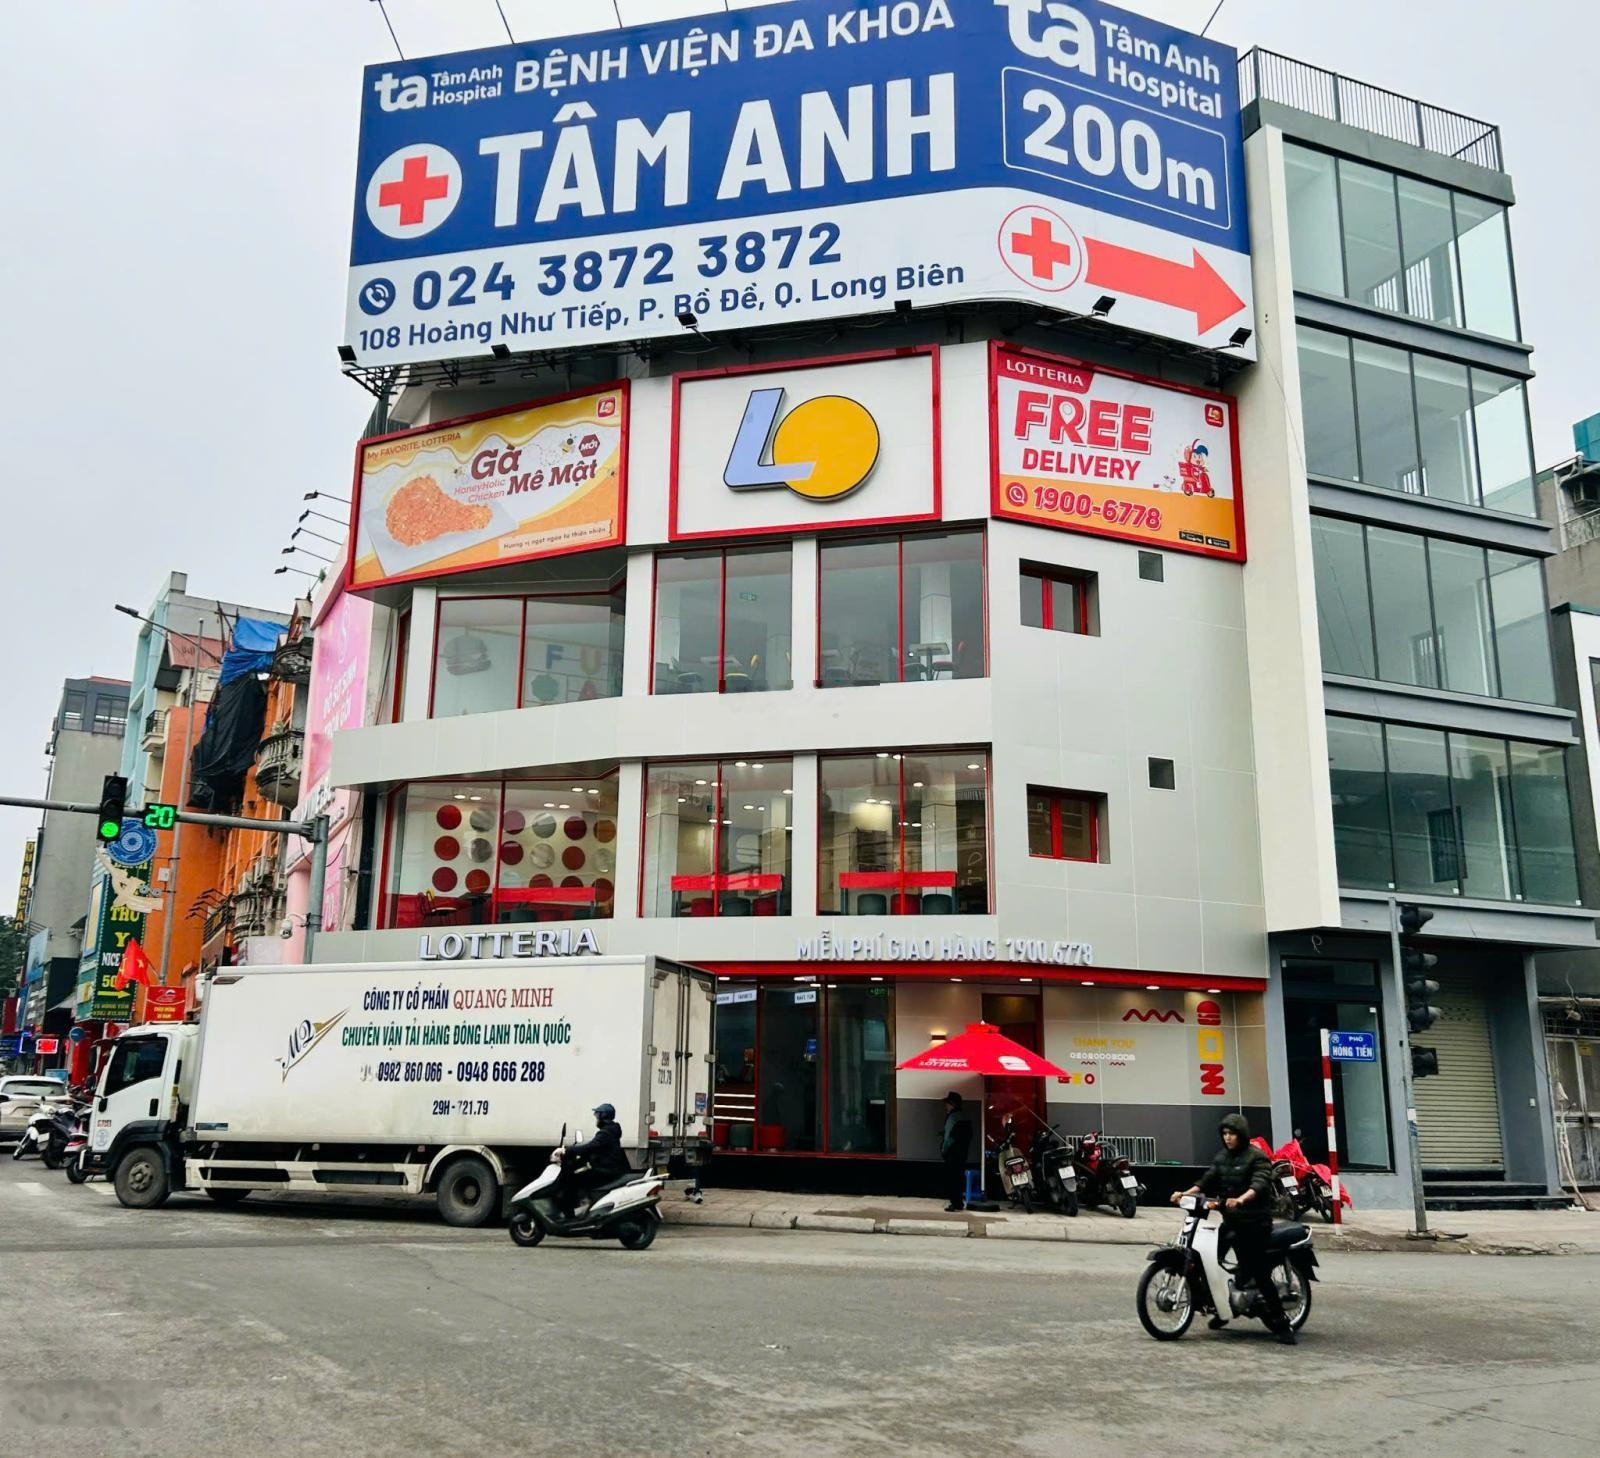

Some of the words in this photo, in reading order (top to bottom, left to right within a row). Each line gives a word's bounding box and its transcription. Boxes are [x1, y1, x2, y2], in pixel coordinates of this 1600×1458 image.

[514, 47, 627, 97] BỆNH
[640, 28, 739, 77] VIỆN
[754, 19, 814, 58] ĐA
[828, 0, 955, 47] KHOA
[1101, 19, 1160, 65] Tâm
[1165, 43, 1220, 85] Anh
[374, 71, 428, 112] ta
[432, 71, 467, 88] Tâm
[468, 65, 503, 82] Anh
[432, 82, 502, 107] Hospital
[1108, 57, 1222, 119] Hospital
[478, 101, 691, 228] TÂM
[716, 72, 956, 200] ANH
[1022, 88, 1215, 211] 200m
[412, 261, 515, 311] 024
[537, 242, 674, 296] 3872
[697, 222, 841, 277] 3872
[359, 326, 401, 351] 108
[408, 313, 492, 347] Hoàng
[500, 311, 556, 336] Như
[562, 300, 629, 331] Tiếp,
[639, 297, 664, 322] P.
[674, 287, 711, 317] Bồ
[720, 281, 765, 313] Đề,
[775, 282, 801, 308] Q.
[812, 275, 886, 302] Long
[896, 263, 964, 291] Biên
[1006, 359, 1084, 387] LOTTERIA
[421, 432, 461, 448] LOTTERIA
[1014, 389, 1153, 455] FREE
[471, 444, 522, 480] Gà
[507, 469, 544, 496] Mê
[548, 459, 598, 487] Mật
[1022, 448, 1141, 481] DELIVERY
[468, 490, 505, 504] Chicken
[1033, 486, 1162, 531] 1900-6778
[145, 805, 174, 828] 20
[114, 932, 130, 948] Y
[419, 927, 602, 961] LOTTERIA
[796, 930, 844, 961] MIỄN
[852, 932, 885, 961] PHÍ
[888, 937, 935, 961] GIAO
[940, 933, 996, 961] HÀNG
[1005, 937, 1094, 966] 1900.6778
[101, 952, 120, 967] NICE
[363, 986, 390, 1011] CÔNG
[392, 990, 405, 1011] TY
[453, 988, 508, 1011] QUANG
[510, 987, 554, 1009] MINH
[341, 1021, 380, 1047] CHUYÊN
[382, 1020, 402, 1051] VẬN
[404, 1017, 421, 1046] TẢI
[422, 1020, 451, 1046] HÀNG
[483, 1023, 511, 1049] LẠNH
[513, 1019, 540, 1045] TOÀN
[543, 1015, 572, 1046] QUỐC
[377, 1061, 401, 1082] 0982
[404, 1061, 424, 1082] 860
[424, 1061, 443, 1082] 066
[457, 1061, 488, 1082] 0948
[492, 1061, 517, 1082] 666
[520, 1061, 546, 1082] 288
